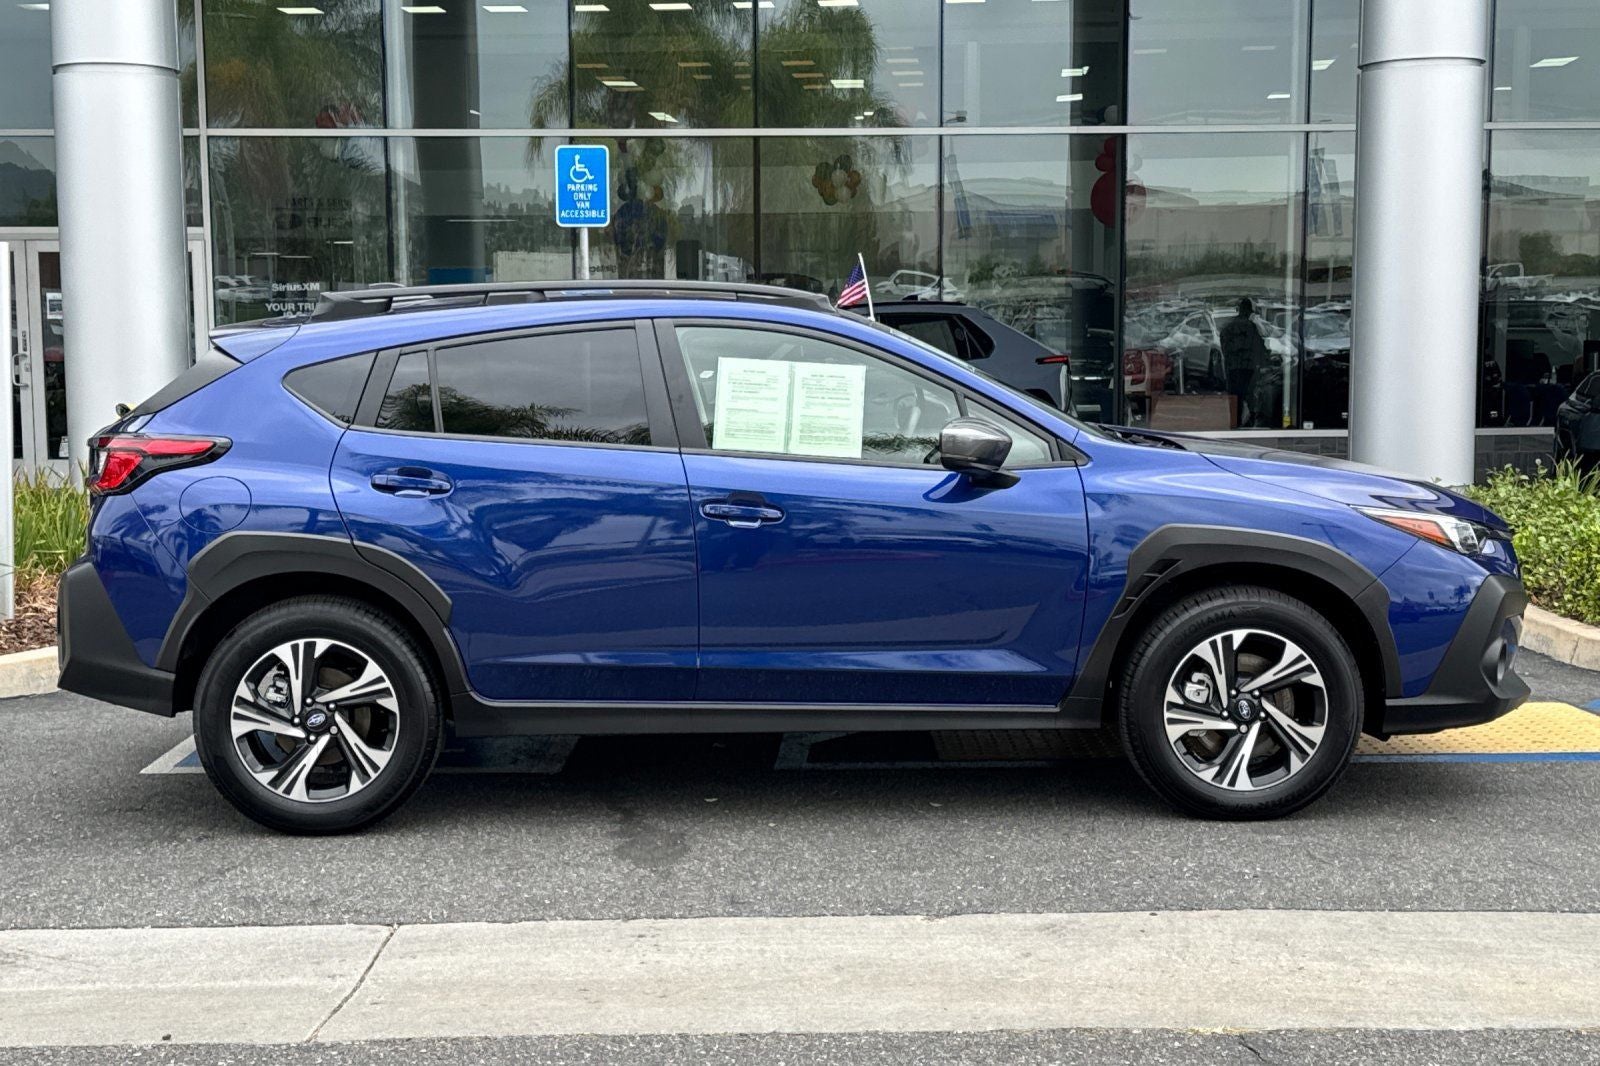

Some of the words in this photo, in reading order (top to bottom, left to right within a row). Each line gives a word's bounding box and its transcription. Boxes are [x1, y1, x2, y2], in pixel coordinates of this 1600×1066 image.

[567, 184, 598, 192] PARKING
[574, 193, 592, 201] ONLY
[576, 201, 590, 209] VAN
[561, 209, 606, 218] ACCESSIBLE
[272, 282, 320, 292] SiriusXM
[265, 302, 296, 312] YOUR
[297, 302, 316, 311] TRI
